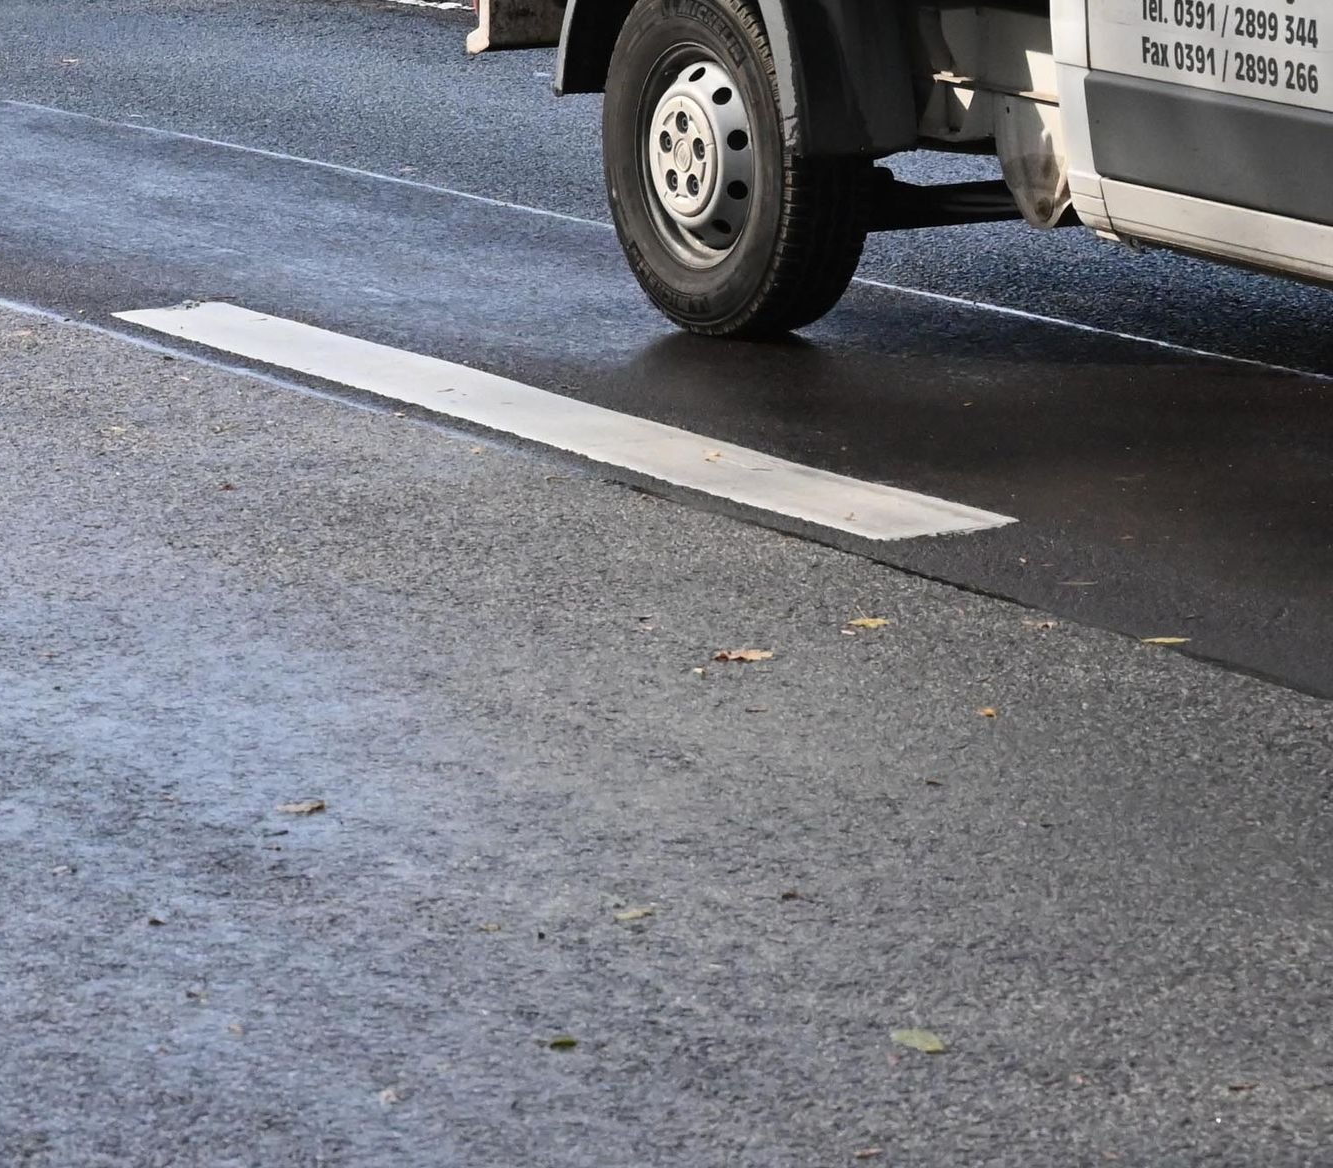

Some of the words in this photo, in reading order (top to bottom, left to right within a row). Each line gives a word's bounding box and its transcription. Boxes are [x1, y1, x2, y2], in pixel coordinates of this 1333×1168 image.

[1234, 7, 1278, 42] 2899
[1284, 15, 1318, 48] 344
[1141, 36, 1169, 67] Fax
[1174, 40, 1215, 75] 0391
[1234, 51, 1278, 87] 2899
[1285, 60, 1319, 93] 266
